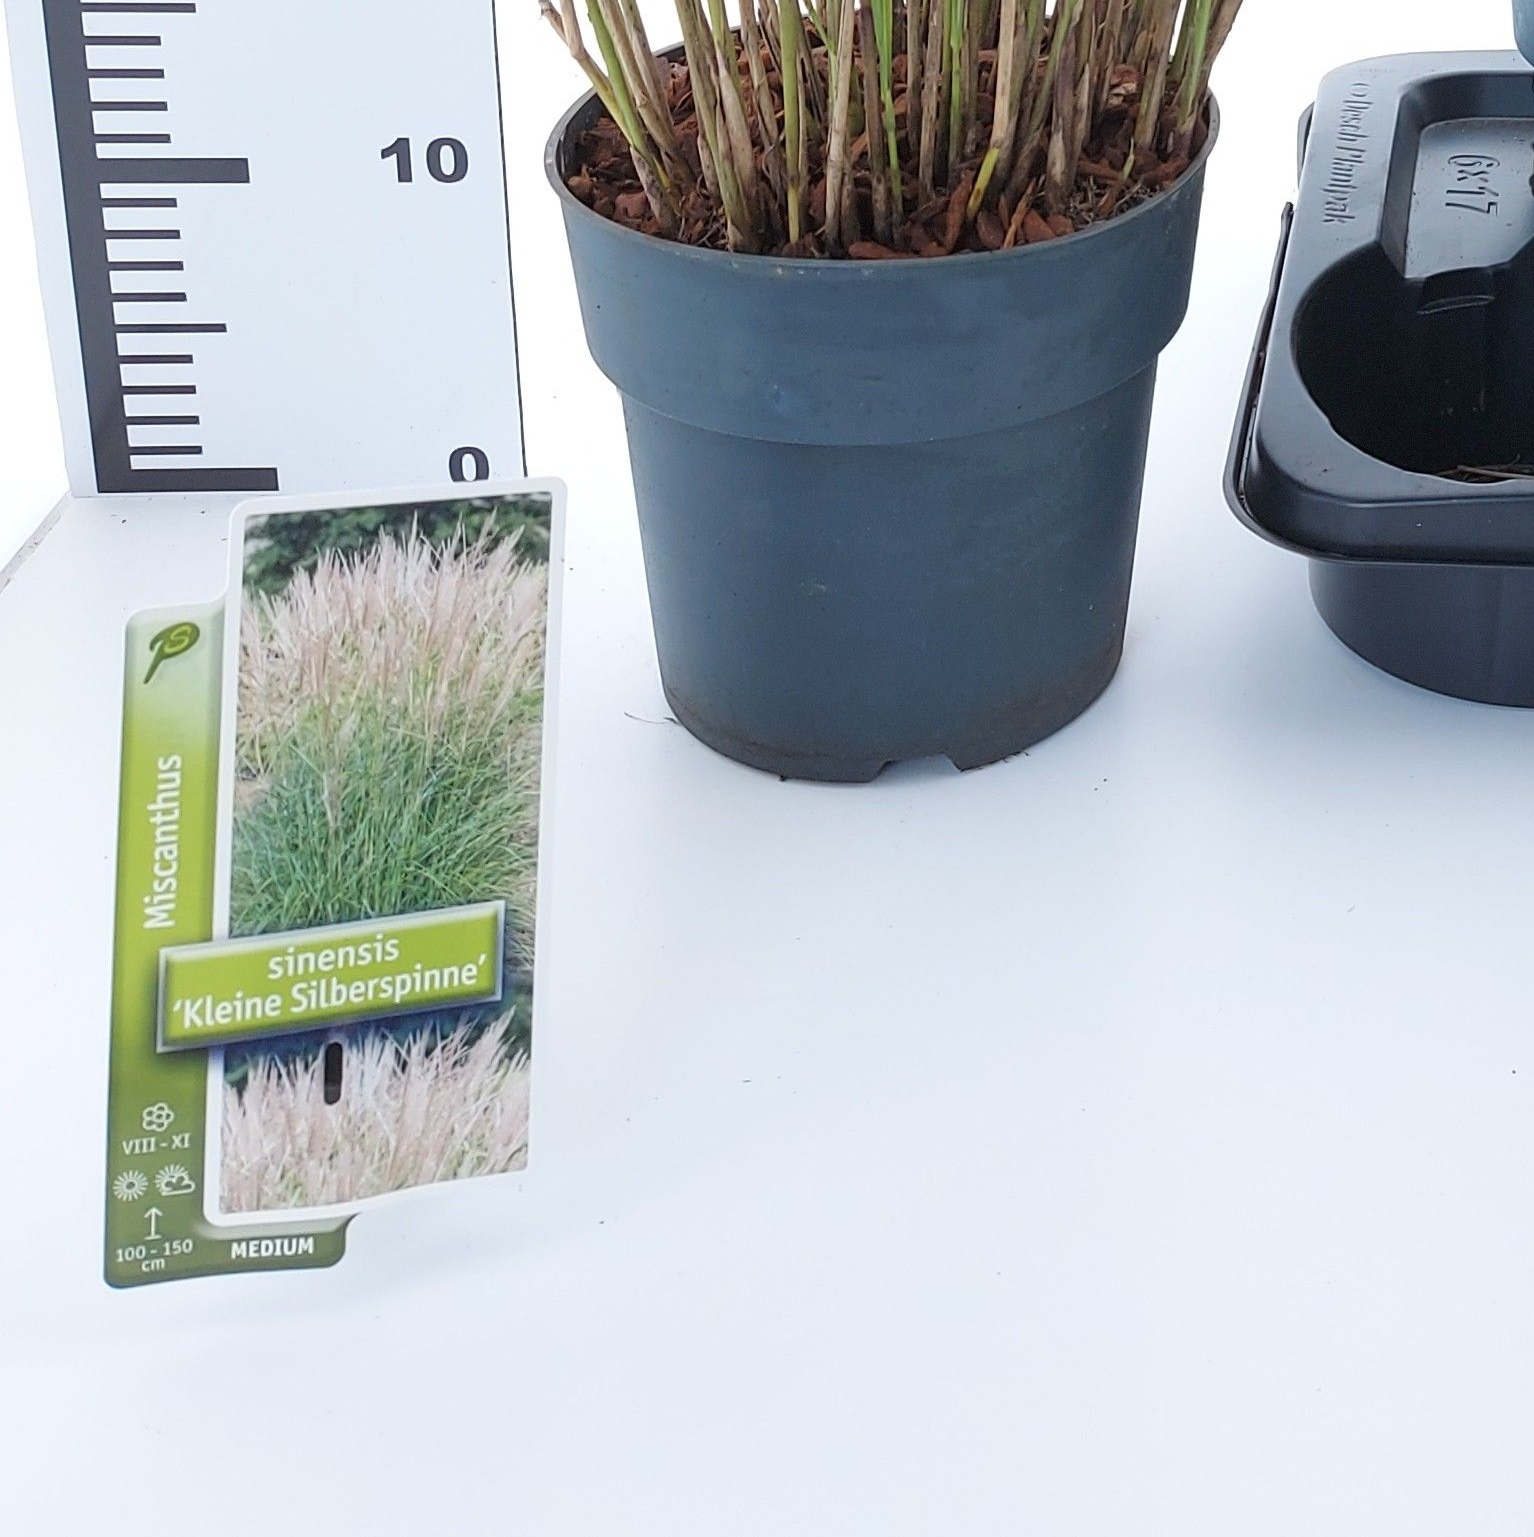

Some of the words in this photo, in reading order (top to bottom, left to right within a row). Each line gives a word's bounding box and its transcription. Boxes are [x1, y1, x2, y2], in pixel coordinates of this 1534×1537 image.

[379, 136, 469, 183] 10
[447, 445, 490, 483] 0
[143, 754, 182, 929] Miscanthus
[267, 934, 401, 980] sinensis
[122, 1137, 156, 1155] VIII
[171, 1133, 192, 1151] XI
[115, 1245, 147, 1261] 100
[164, 1239, 193, 1255] 150
[231, 1237, 314, 1260] MEDIUM
[141, 1257, 165, 1272] cm
